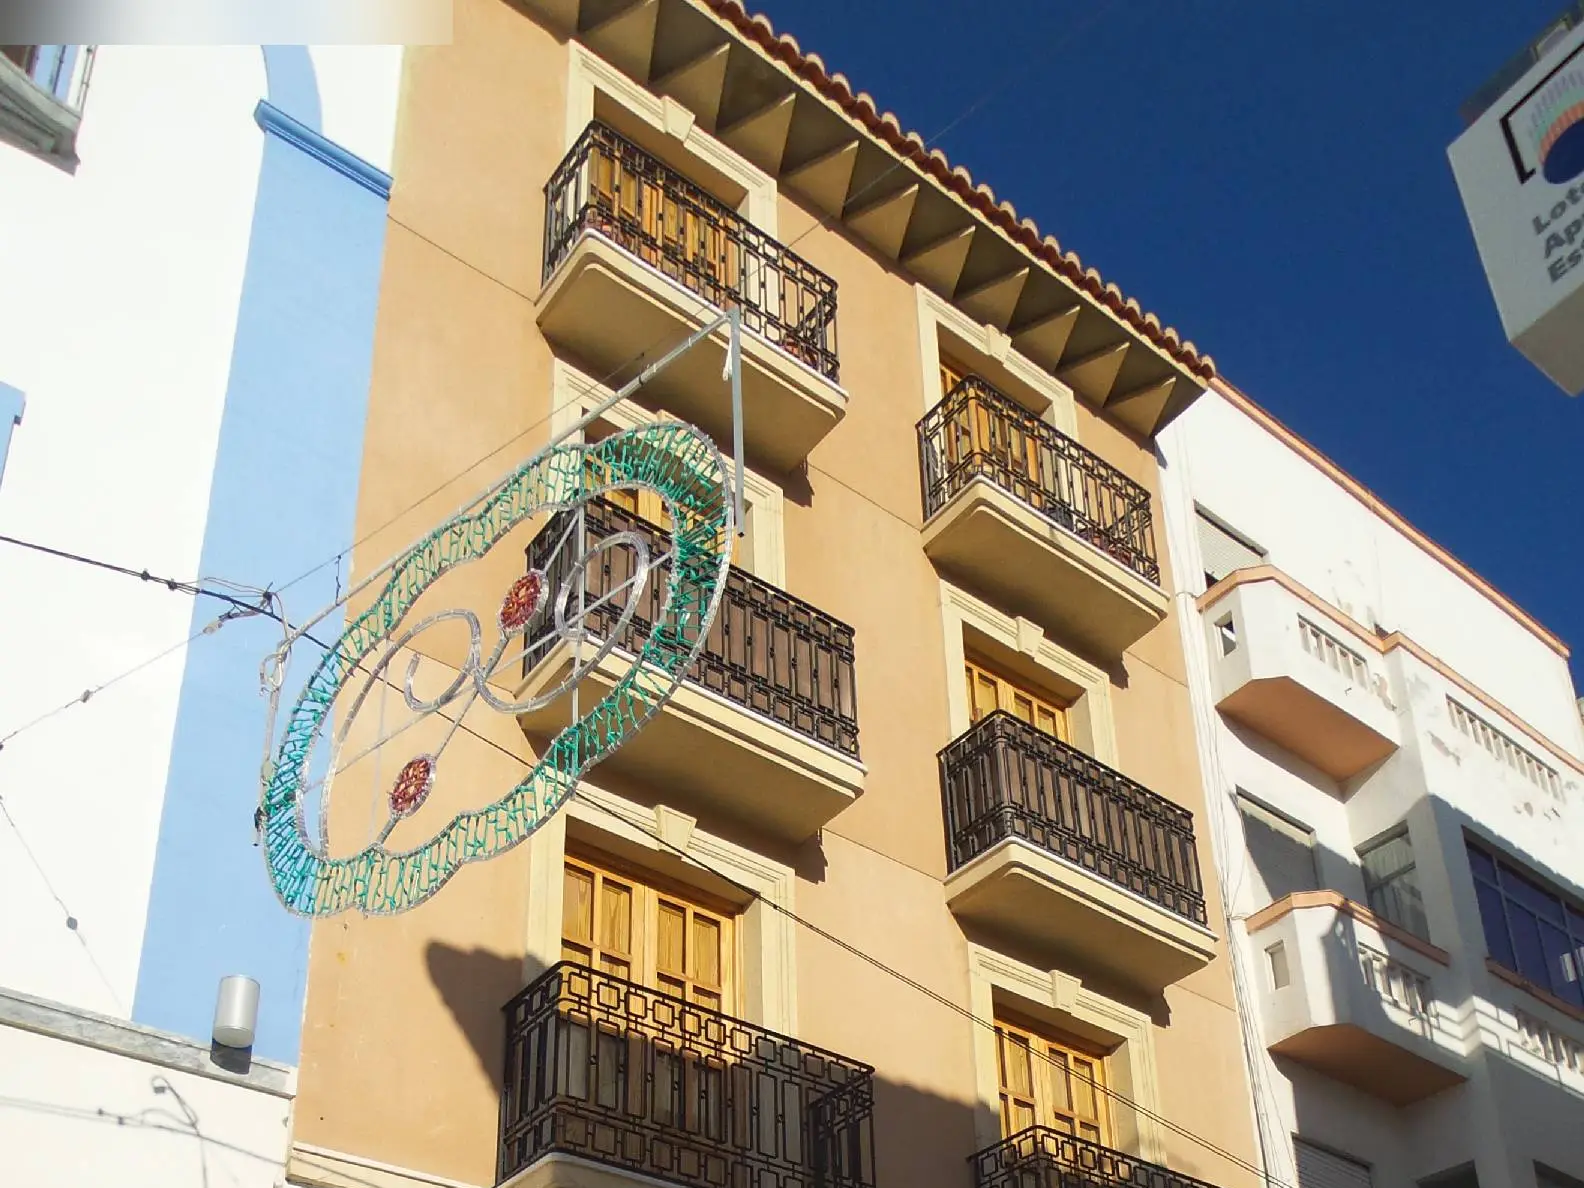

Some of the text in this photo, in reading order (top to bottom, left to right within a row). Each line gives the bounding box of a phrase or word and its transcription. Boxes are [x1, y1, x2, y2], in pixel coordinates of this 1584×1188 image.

[1533, 181, 1584, 235] Lot
[1545, 212, 1584, 259] Ap
[1548, 238, 1584, 283] Es
